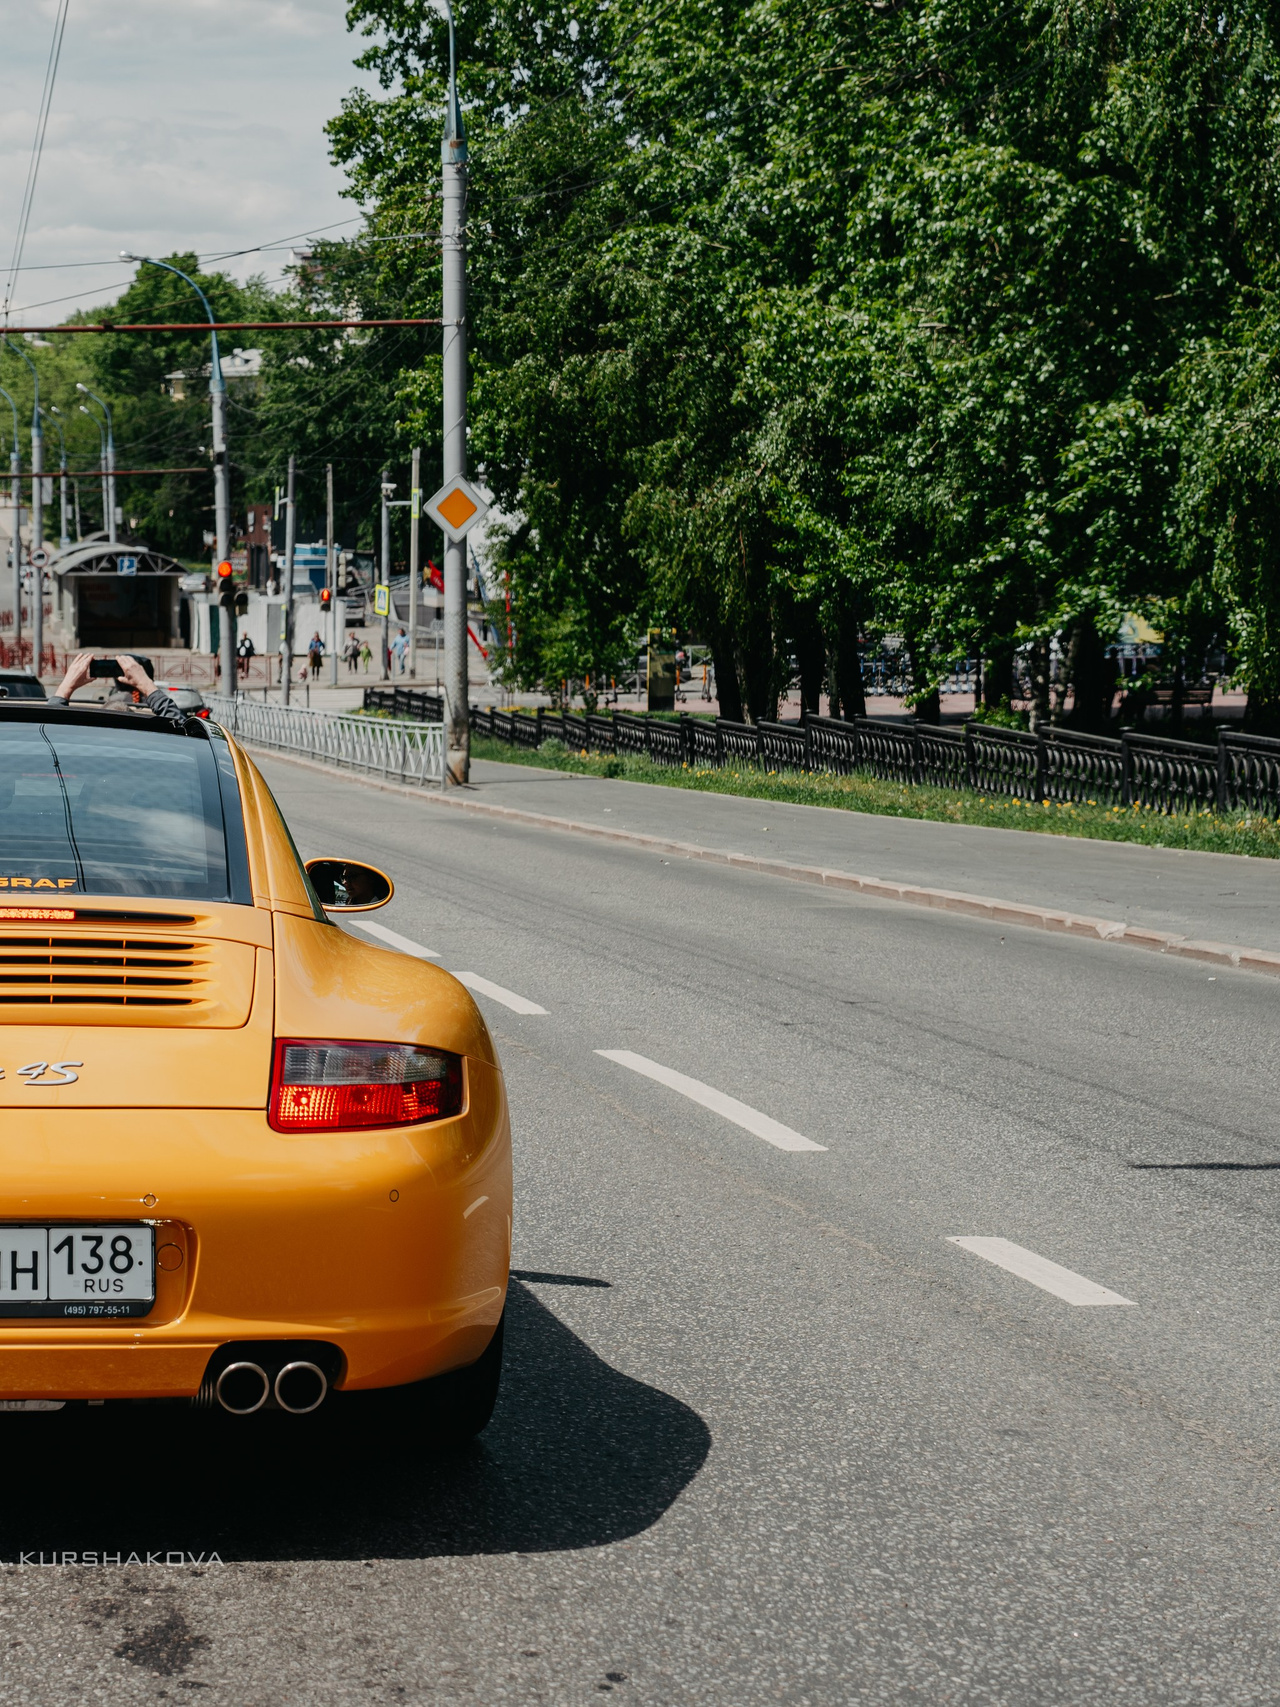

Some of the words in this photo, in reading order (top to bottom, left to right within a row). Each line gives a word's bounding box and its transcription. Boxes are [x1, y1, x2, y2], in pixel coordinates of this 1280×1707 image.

[17, 1061, 84, 1086] 4S
[53, 1235, 134, 1275] 138
[84, 1278, 124, 1293] RUS
[64, 1305, 86, 1315] (495)
[88, 1305, 130, 1314] 797-55-11
